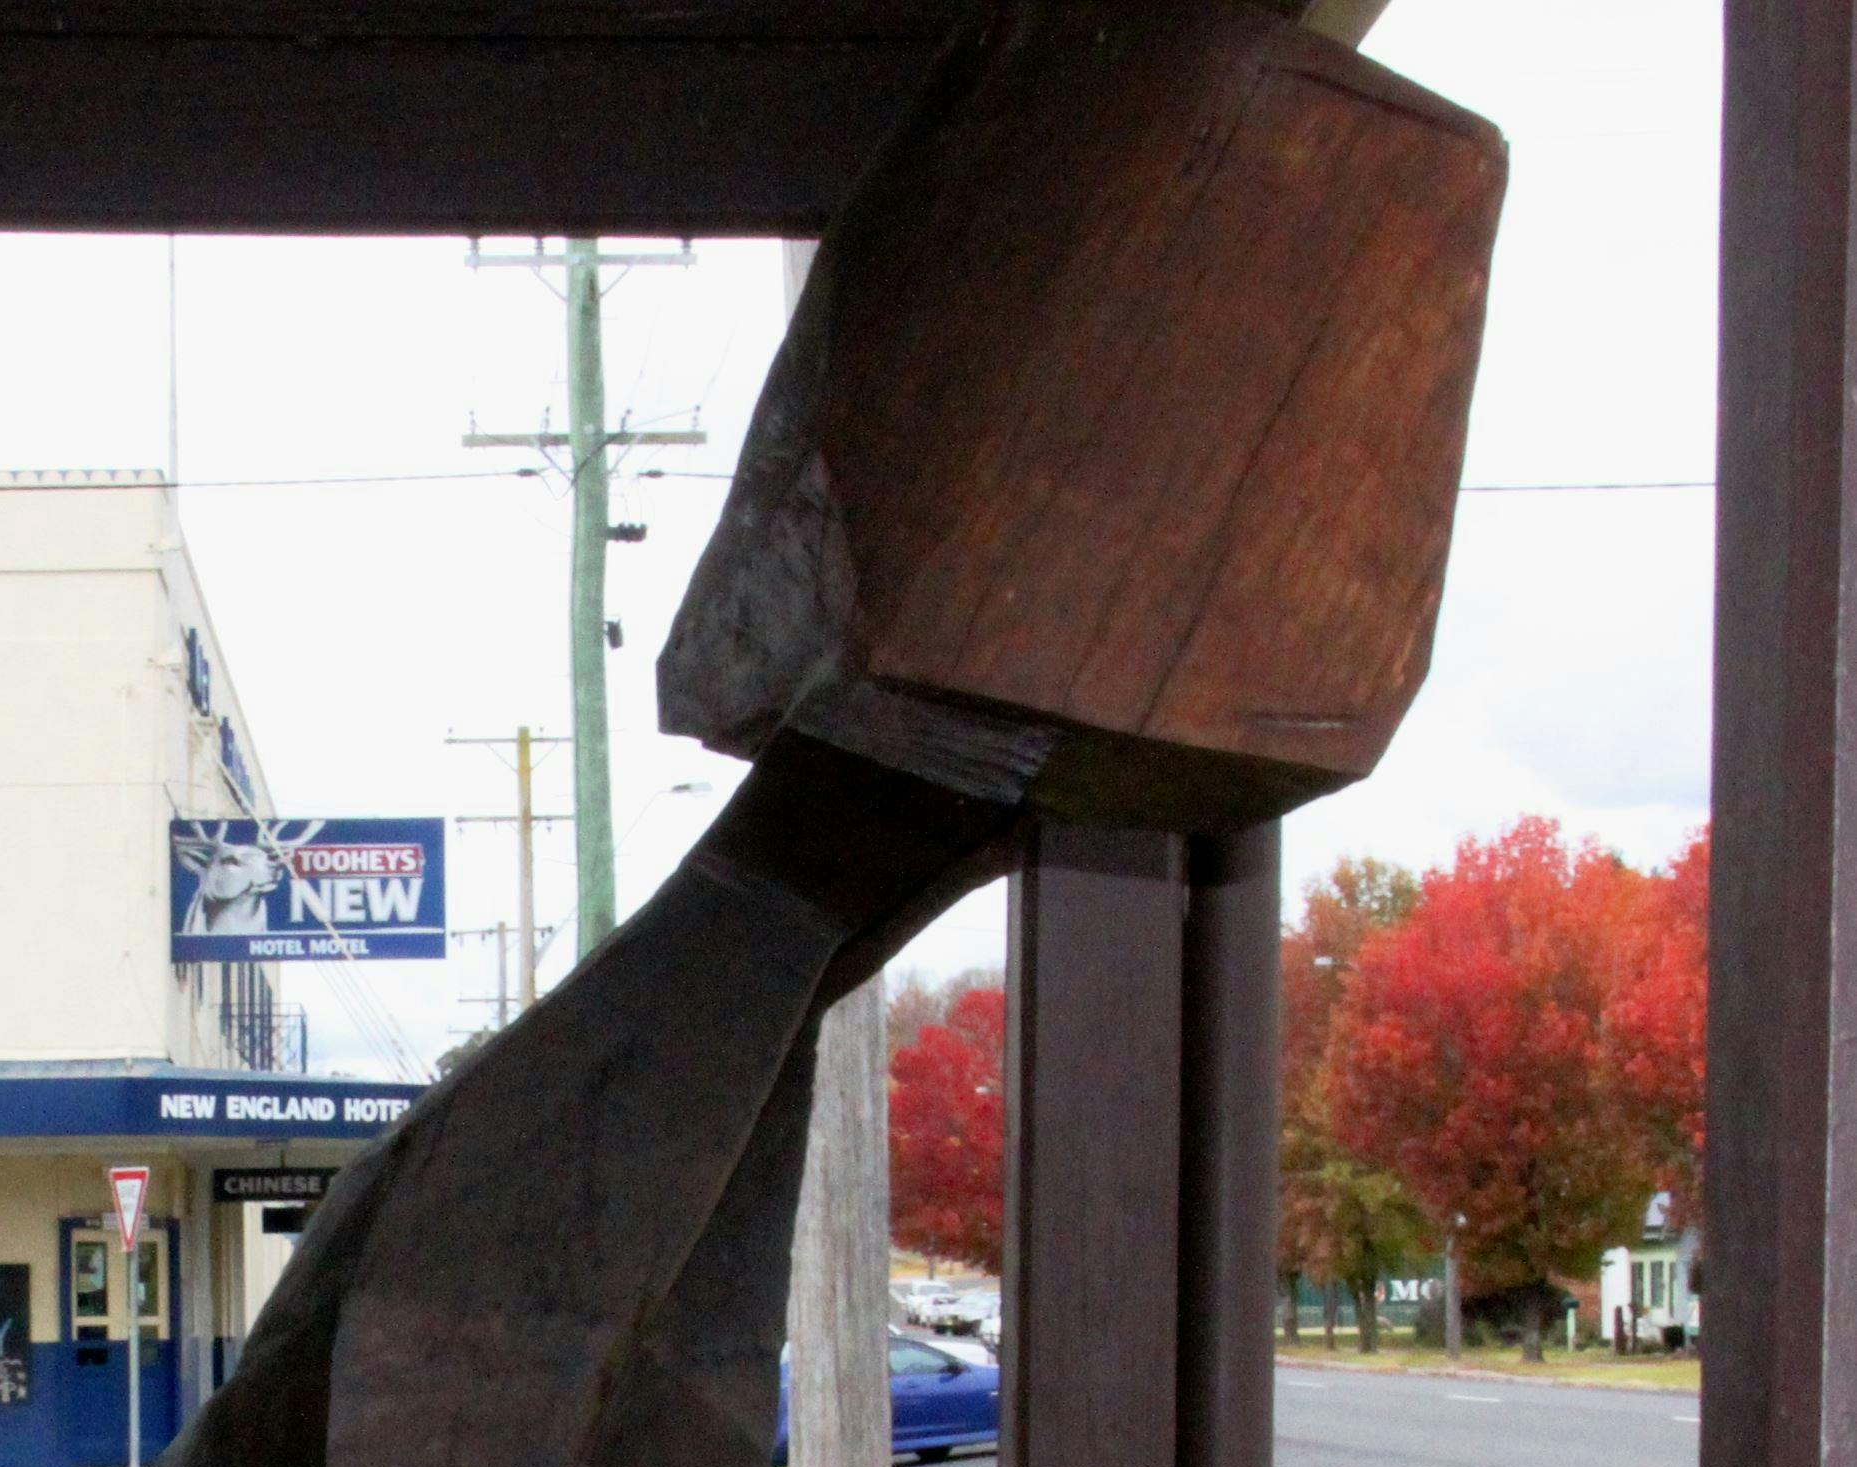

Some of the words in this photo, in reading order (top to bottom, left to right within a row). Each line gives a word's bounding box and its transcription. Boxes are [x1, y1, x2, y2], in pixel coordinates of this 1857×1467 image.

[298, 849, 417, 872] TOOHEYS
[290, 878, 423, 923] NEW
[249, 939, 305, 956] HOTEL
[309, 938, 370, 955] MOTEL
[160, 1094, 216, 1119] NEW
[225, 1095, 336, 1121] ENGLAND
[224, 1175, 322, 1194] CHINESE
